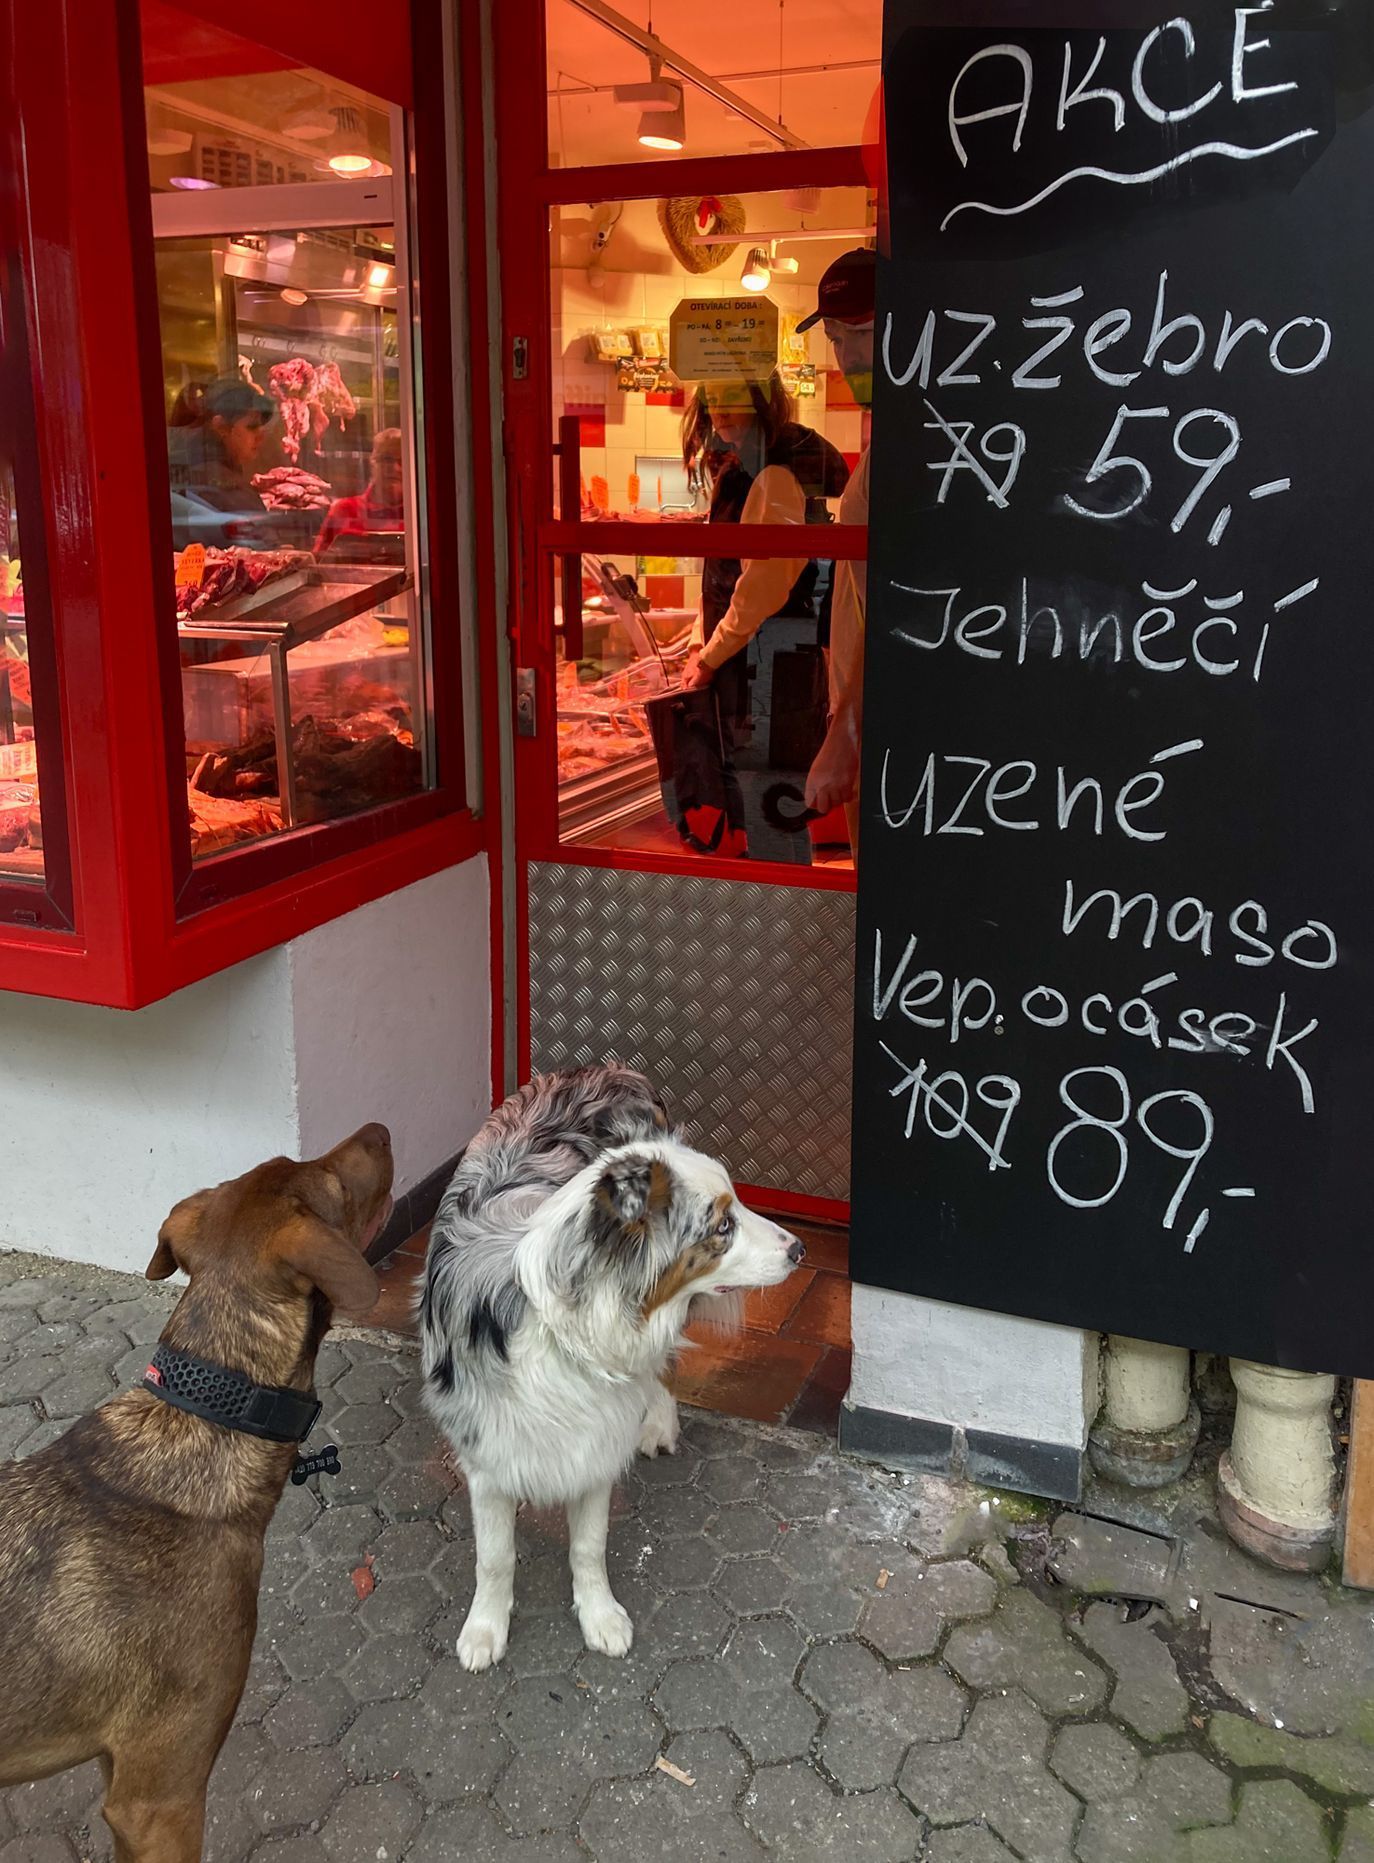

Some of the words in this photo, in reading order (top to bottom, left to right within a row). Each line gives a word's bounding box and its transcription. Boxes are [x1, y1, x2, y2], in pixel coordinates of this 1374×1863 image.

[949, 0, 1297, 168] AKCE
[690, 300, 731, 311] OTEVÍRACÍ
[715, 318, 722, 330] 8
[742, 318, 756, 329] 19
[890, 578, 1319, 682] Jehněčí
[1063, 880, 1337, 969] maso
